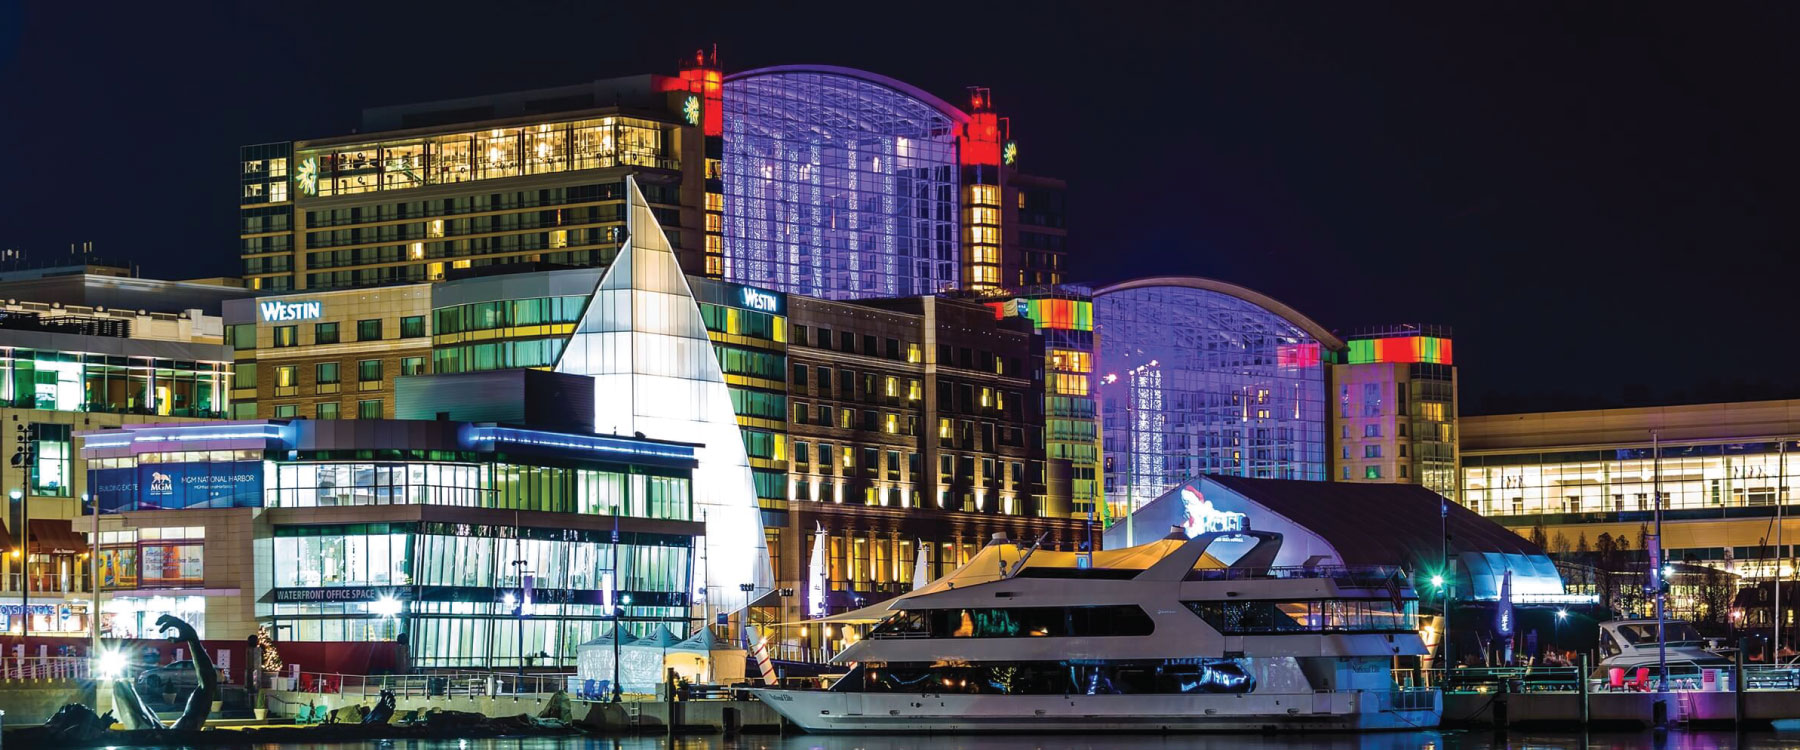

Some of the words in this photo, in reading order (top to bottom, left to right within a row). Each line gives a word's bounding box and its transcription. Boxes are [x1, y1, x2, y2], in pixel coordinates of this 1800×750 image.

[744, 287, 777, 312] WESTIN
[260, 301, 321, 322] WESTIN
[181, 476, 197, 484] MGM
[228, 474, 255, 482] HARBOR
[150, 483, 173, 491] MGM
[277, 590, 324, 600] WATERFRONT
[326, 589, 350, 599] OFFICE
[351, 588, 375, 599] SPACE
